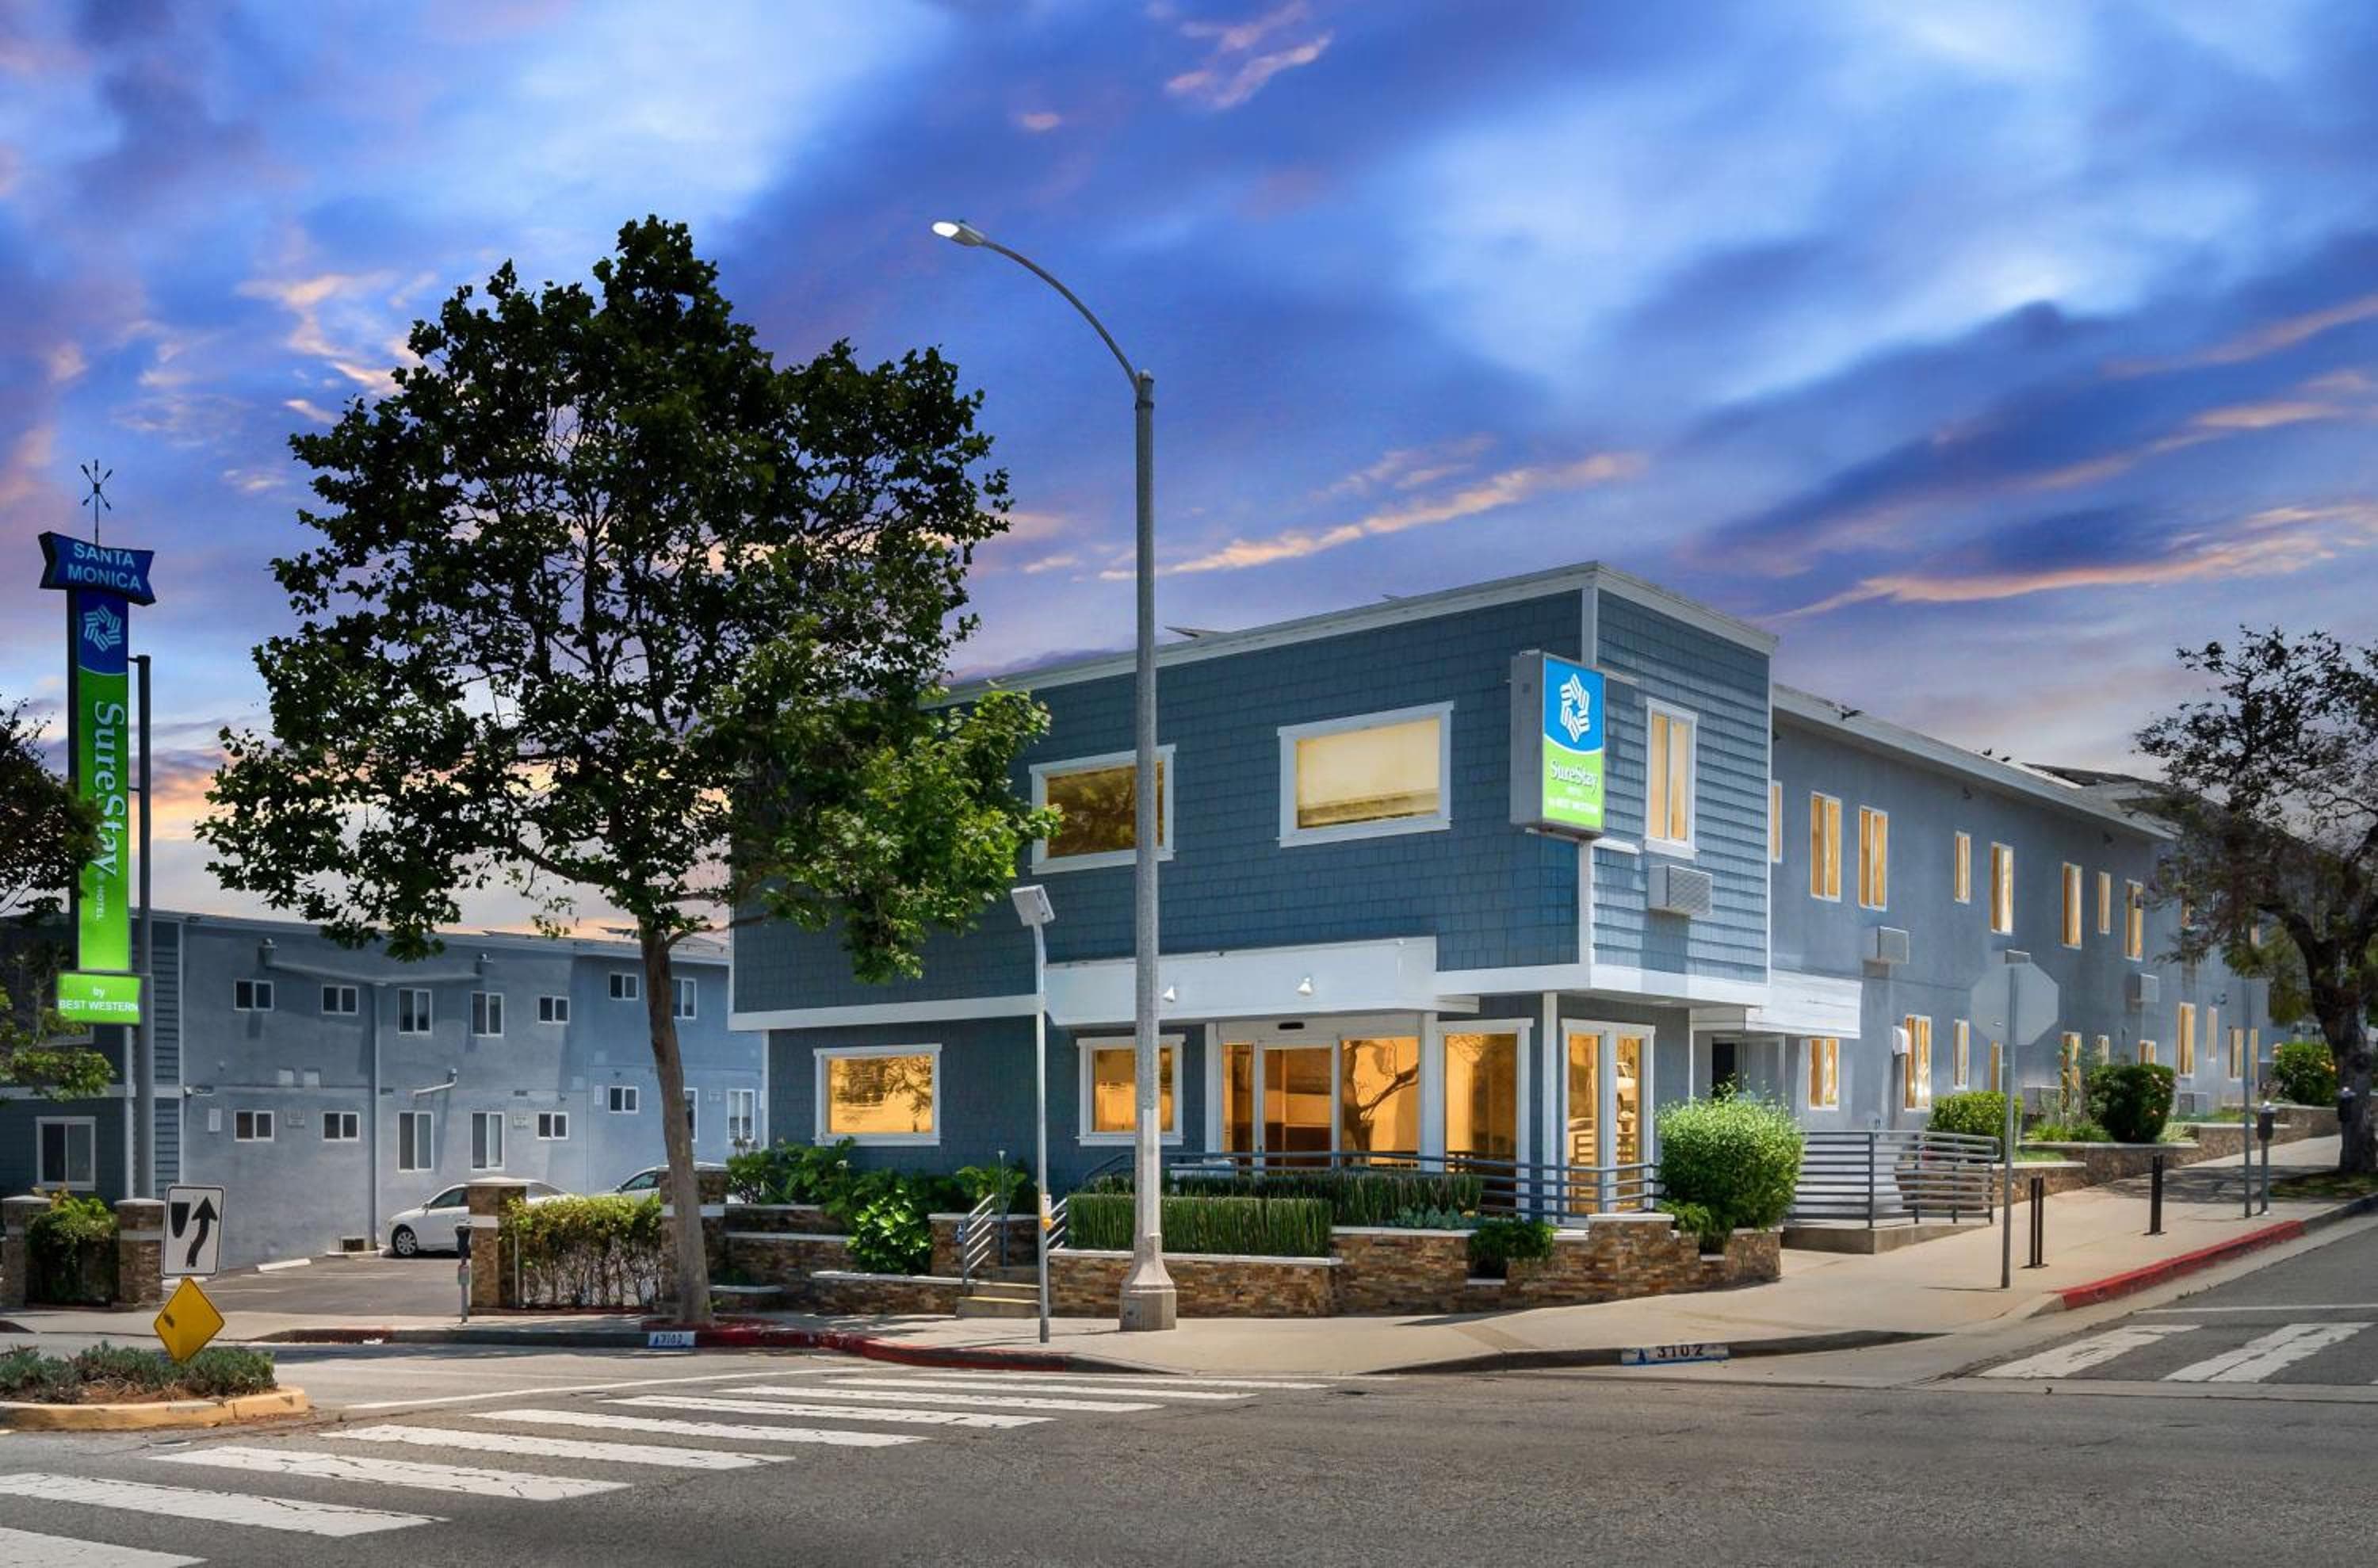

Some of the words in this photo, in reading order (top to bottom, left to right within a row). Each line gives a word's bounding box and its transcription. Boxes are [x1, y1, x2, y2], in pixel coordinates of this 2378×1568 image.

[74, 542, 135, 568] SANTA
[67, 563, 141, 591] MONICA
[94, 701, 126, 876] SureStay
[96, 885, 105, 920] HOTEL
[58, 1000, 86, 1011] BEST
[88, 1001, 139, 1012] WESTERN
[93, 987, 105, 999] by
[1656, 1344, 1703, 1358] 3102
